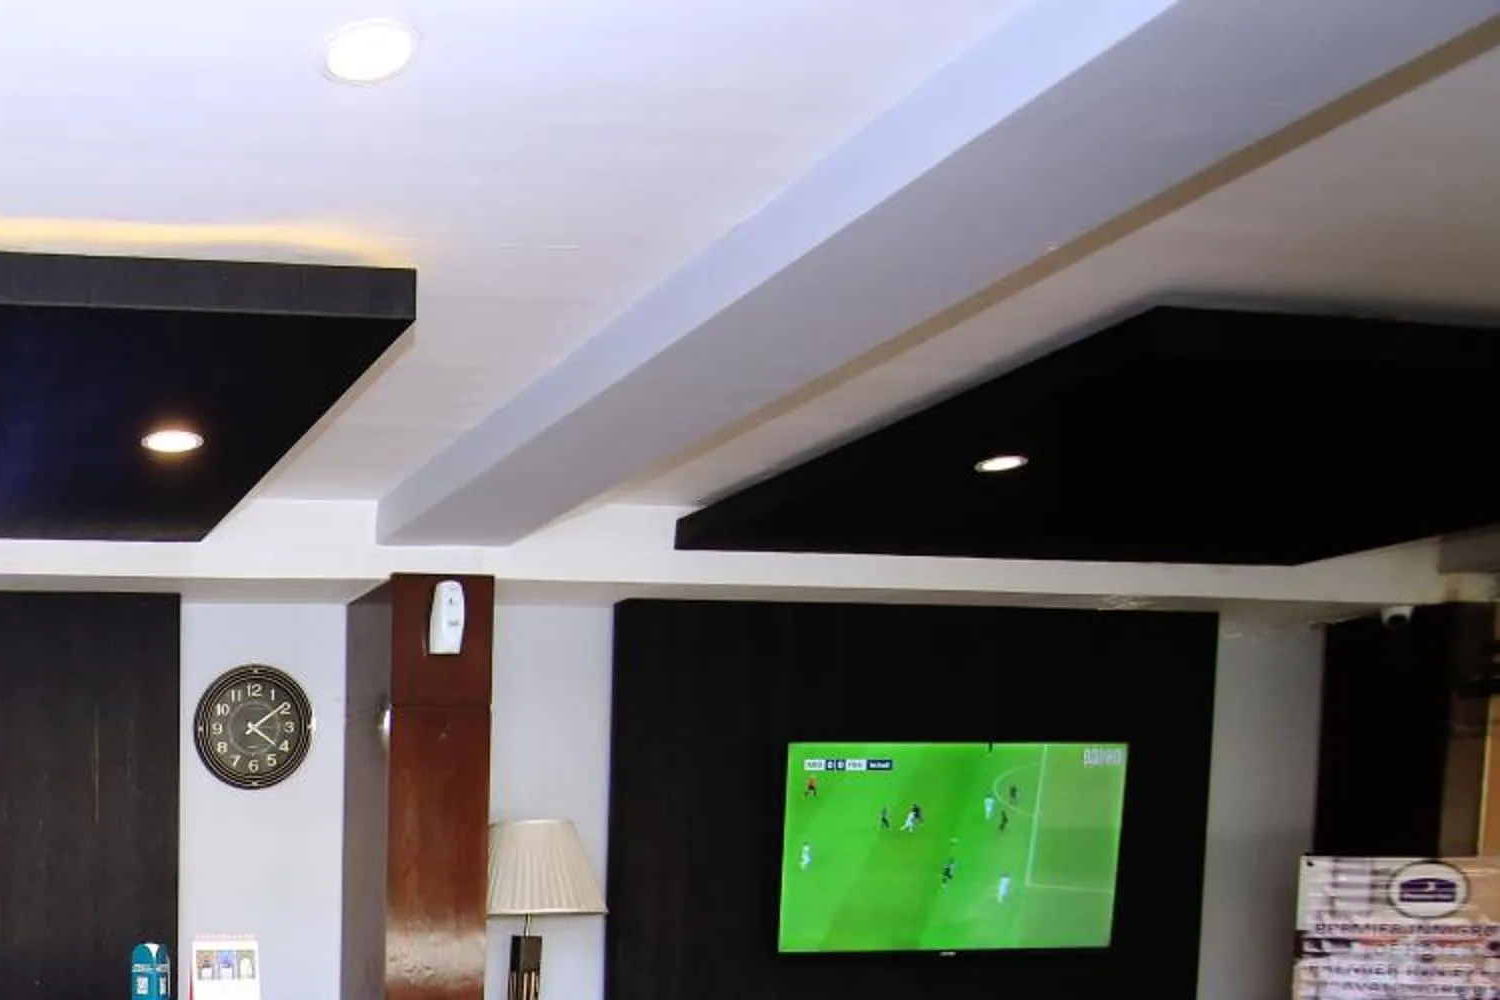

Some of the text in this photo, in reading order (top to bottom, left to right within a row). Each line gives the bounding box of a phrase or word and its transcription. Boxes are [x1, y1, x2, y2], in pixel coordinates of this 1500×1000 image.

[231, 689, 241, 701] 11
[247, 683, 262, 697] 12
[270, 688, 275, 701] 1
[216, 703, 230, 716] 10
[280, 702, 291, 715] 2
[211, 722, 223, 735] 9
[284, 721, 295, 733] 3
[216, 741, 228, 753] 8
[279, 739, 290, 752] 4
[230, 755, 241, 767] 7
[248, 760, 259, 772] 6
[267, 753, 277, 767] 5
